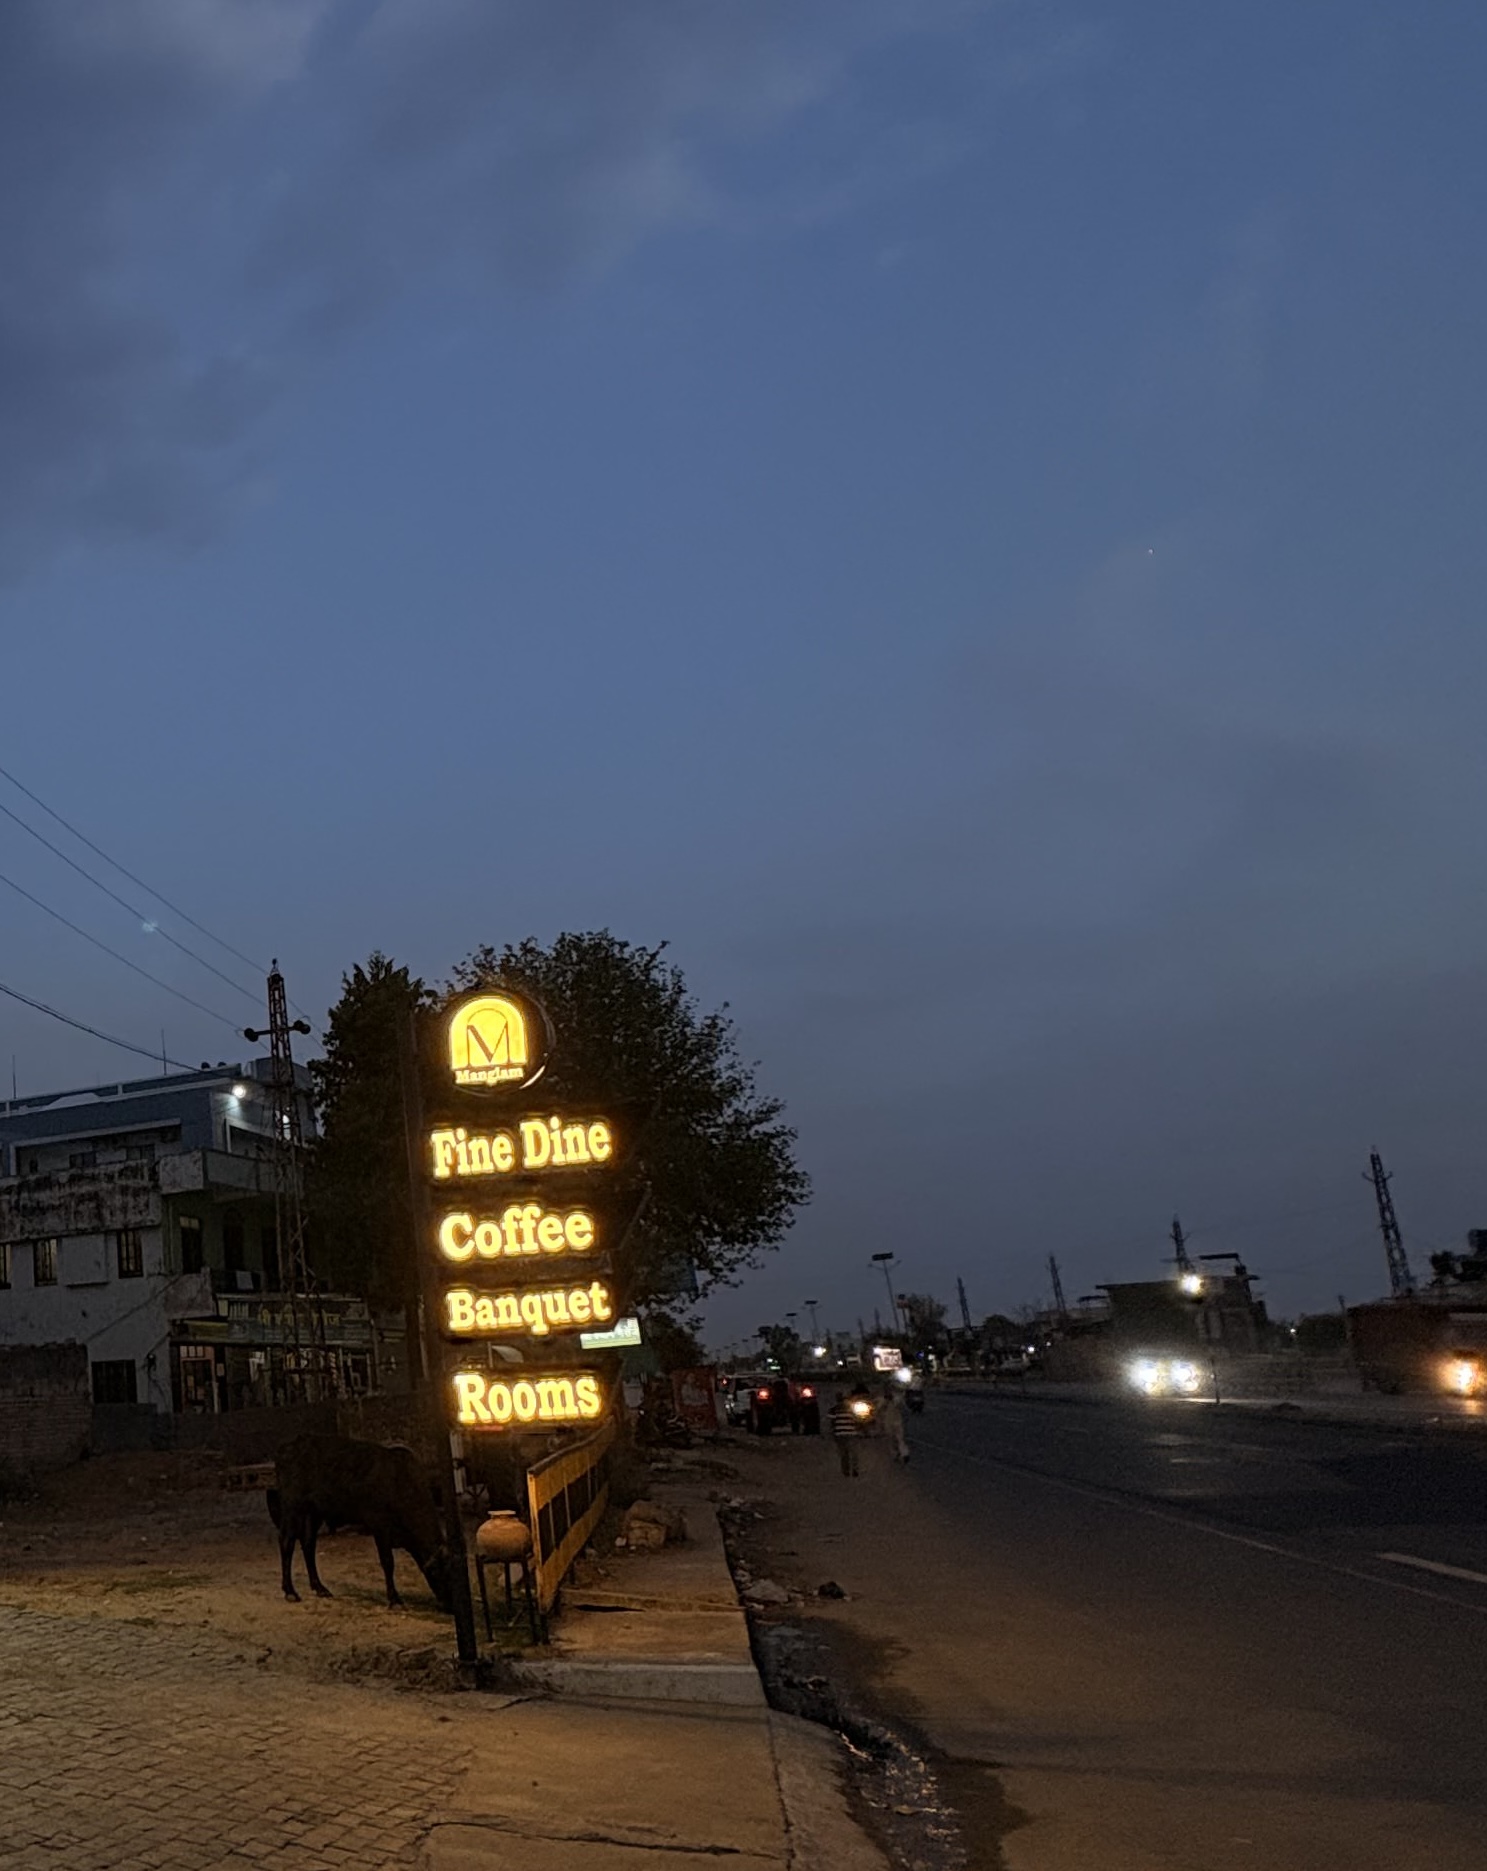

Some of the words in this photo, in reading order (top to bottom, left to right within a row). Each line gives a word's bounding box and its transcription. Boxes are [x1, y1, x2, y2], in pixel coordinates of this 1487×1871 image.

[430, 1127, 513, 1179] Fine
[519, 1116, 612, 1169] Dine
[439, 1203, 594, 1260] Coffee
[446, 1281, 612, 1335] Banquet
[453, 1372, 601, 1424] Rooms
